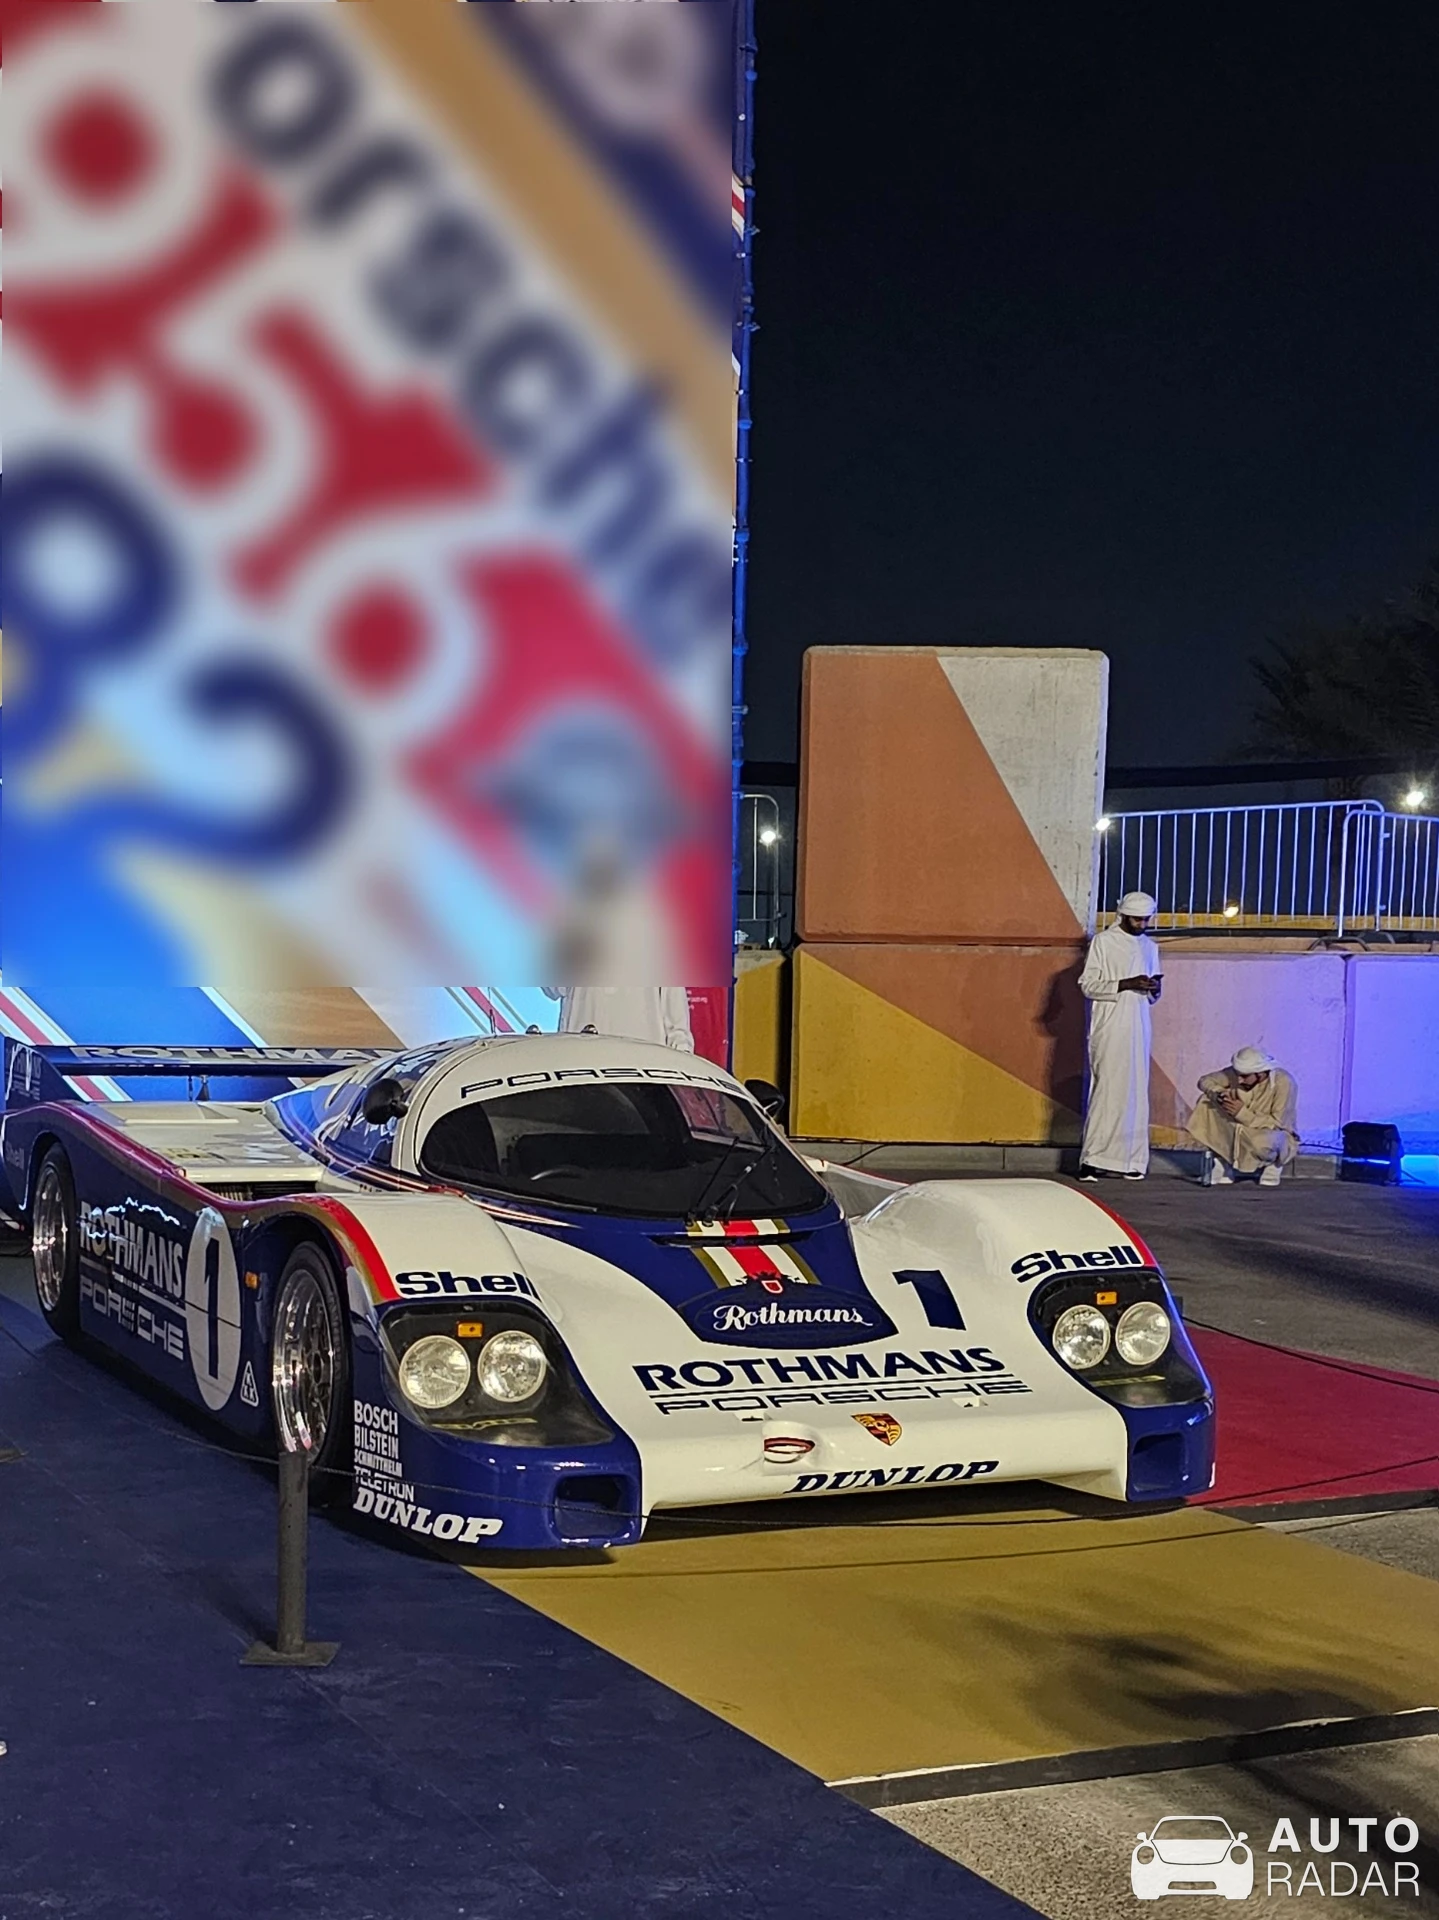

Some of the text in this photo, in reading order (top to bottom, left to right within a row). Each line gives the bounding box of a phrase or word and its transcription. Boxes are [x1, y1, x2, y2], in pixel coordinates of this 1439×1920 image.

[461, 1067, 744, 1099] PORSCHE
[80, 1201, 183, 1299] ROTHMANS
[1010, 1245, 1143, 1283] Shell
[395, 1271, 542, 1303] Shell
[892, 1269, 966, 1332] 1
[80, 1274, 184, 1361] PORSCHE
[204, 1237, 219, 1381] 1
[713, 1302, 873, 1331] Rothmans
[632, 1347, 1006, 1392] ROTHMANS
[656, 1380, 1033, 1416] PORSCHE
[354, 1400, 398, 1435] BOSCH
[354, 1425, 399, 1459] BILSTEIN
[784, 1460, 999, 1494] DUNLOP
[352, 1487, 503, 1544] DUNLOP
